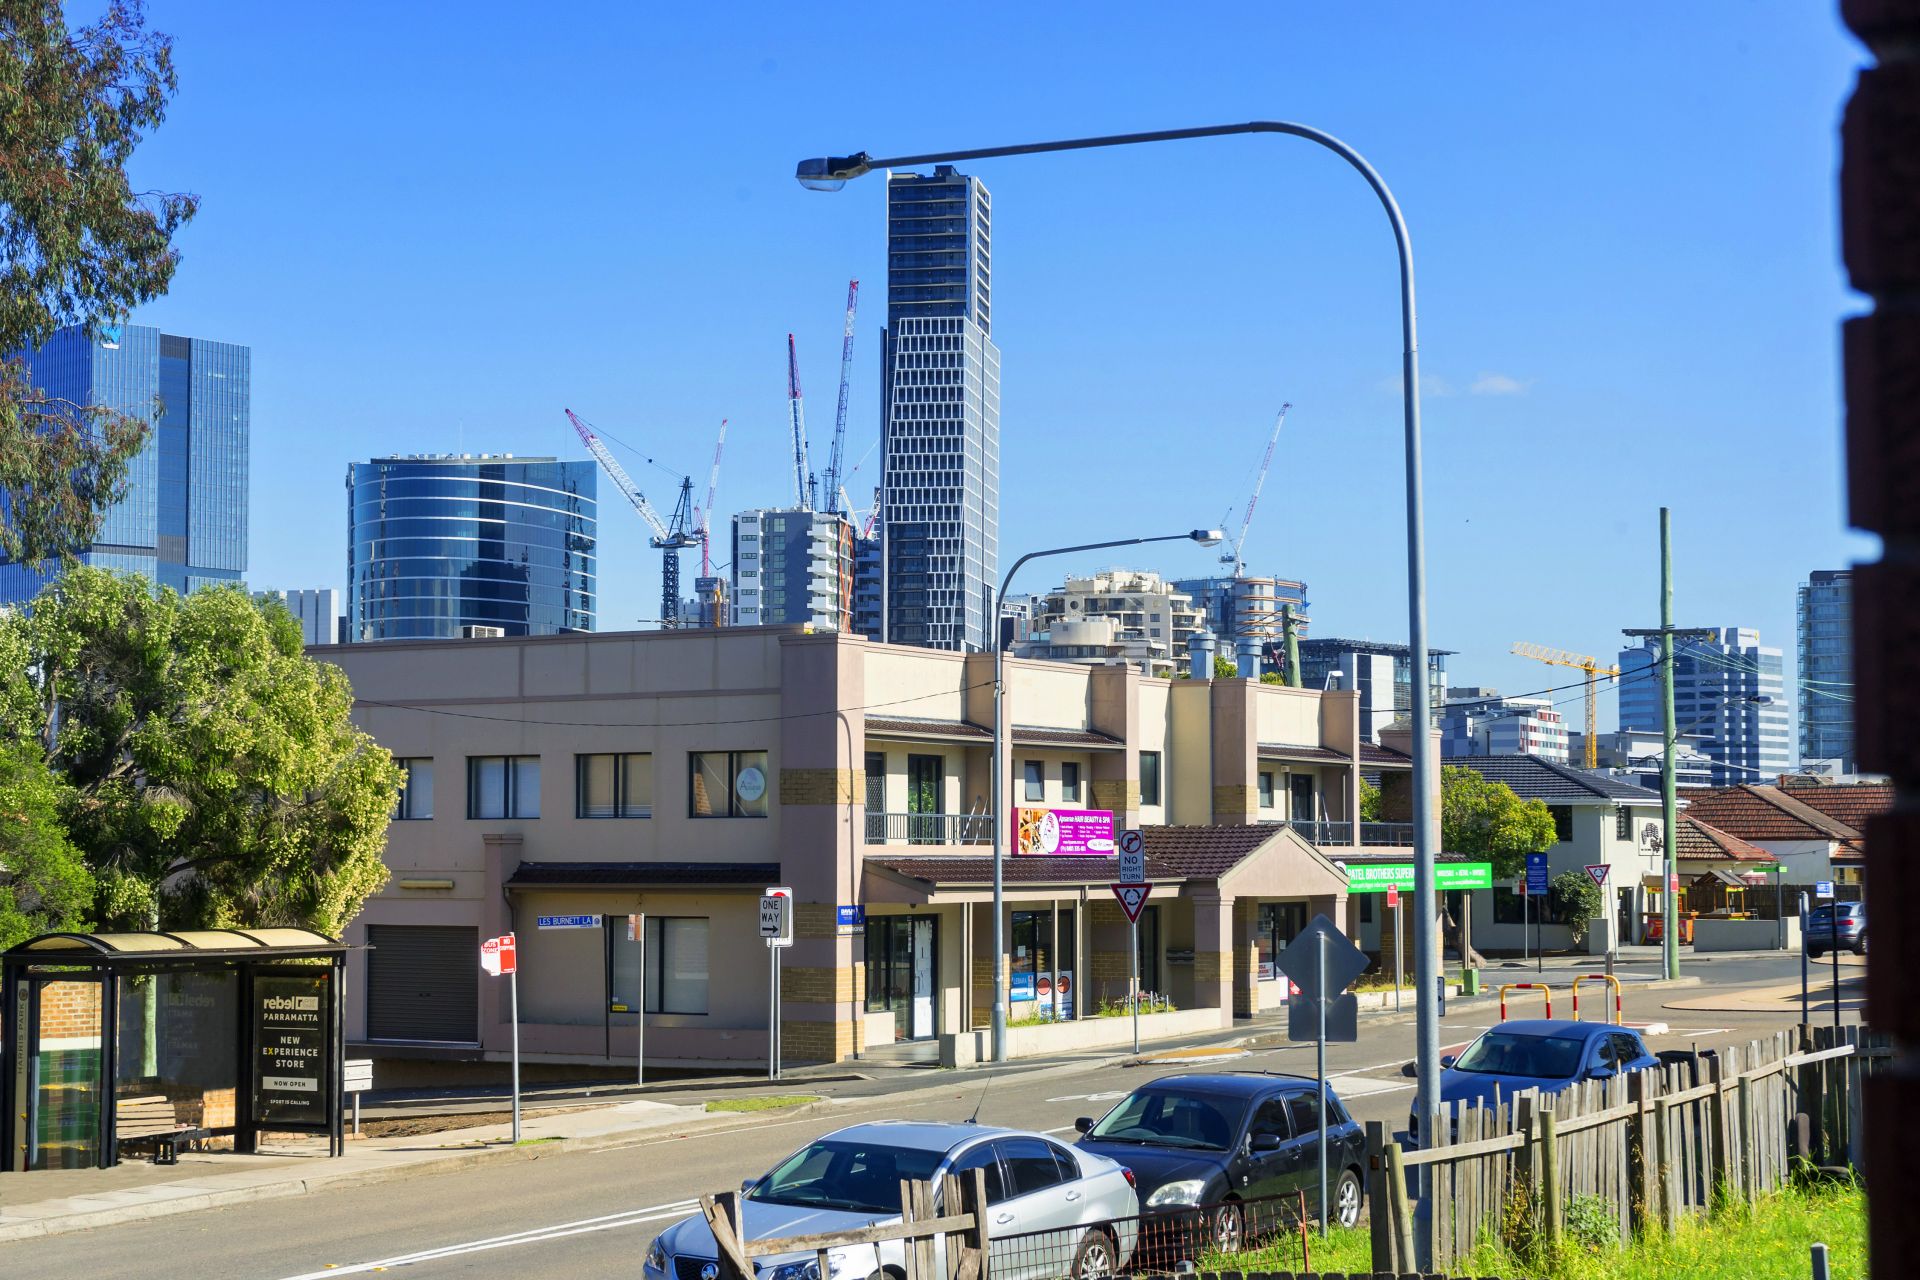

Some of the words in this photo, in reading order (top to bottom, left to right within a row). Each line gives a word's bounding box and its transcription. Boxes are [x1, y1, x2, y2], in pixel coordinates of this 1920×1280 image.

[1124, 856, 1138, 864] NO
[1122, 865, 1142, 873] RIGHT
[1348, 868, 1365, 880] PATEL
[1366, 868, 1394, 880] BROTHERS
[762, 900, 779, 909] ONE
[539, 918, 551, 926] LES
[552, 917, 581, 926] BURNETT
[582, 916, 592, 925] LA
[761, 913, 780, 922] WAY
[263, 996, 295, 1010] rebel
[263, 1012, 318, 1022] PARRAMATTA
[280, 1036, 301, 1045] NEW
[262, 1047, 318, 1057] EXPERIENCE
[275, 1059, 305, 1068] STORE
